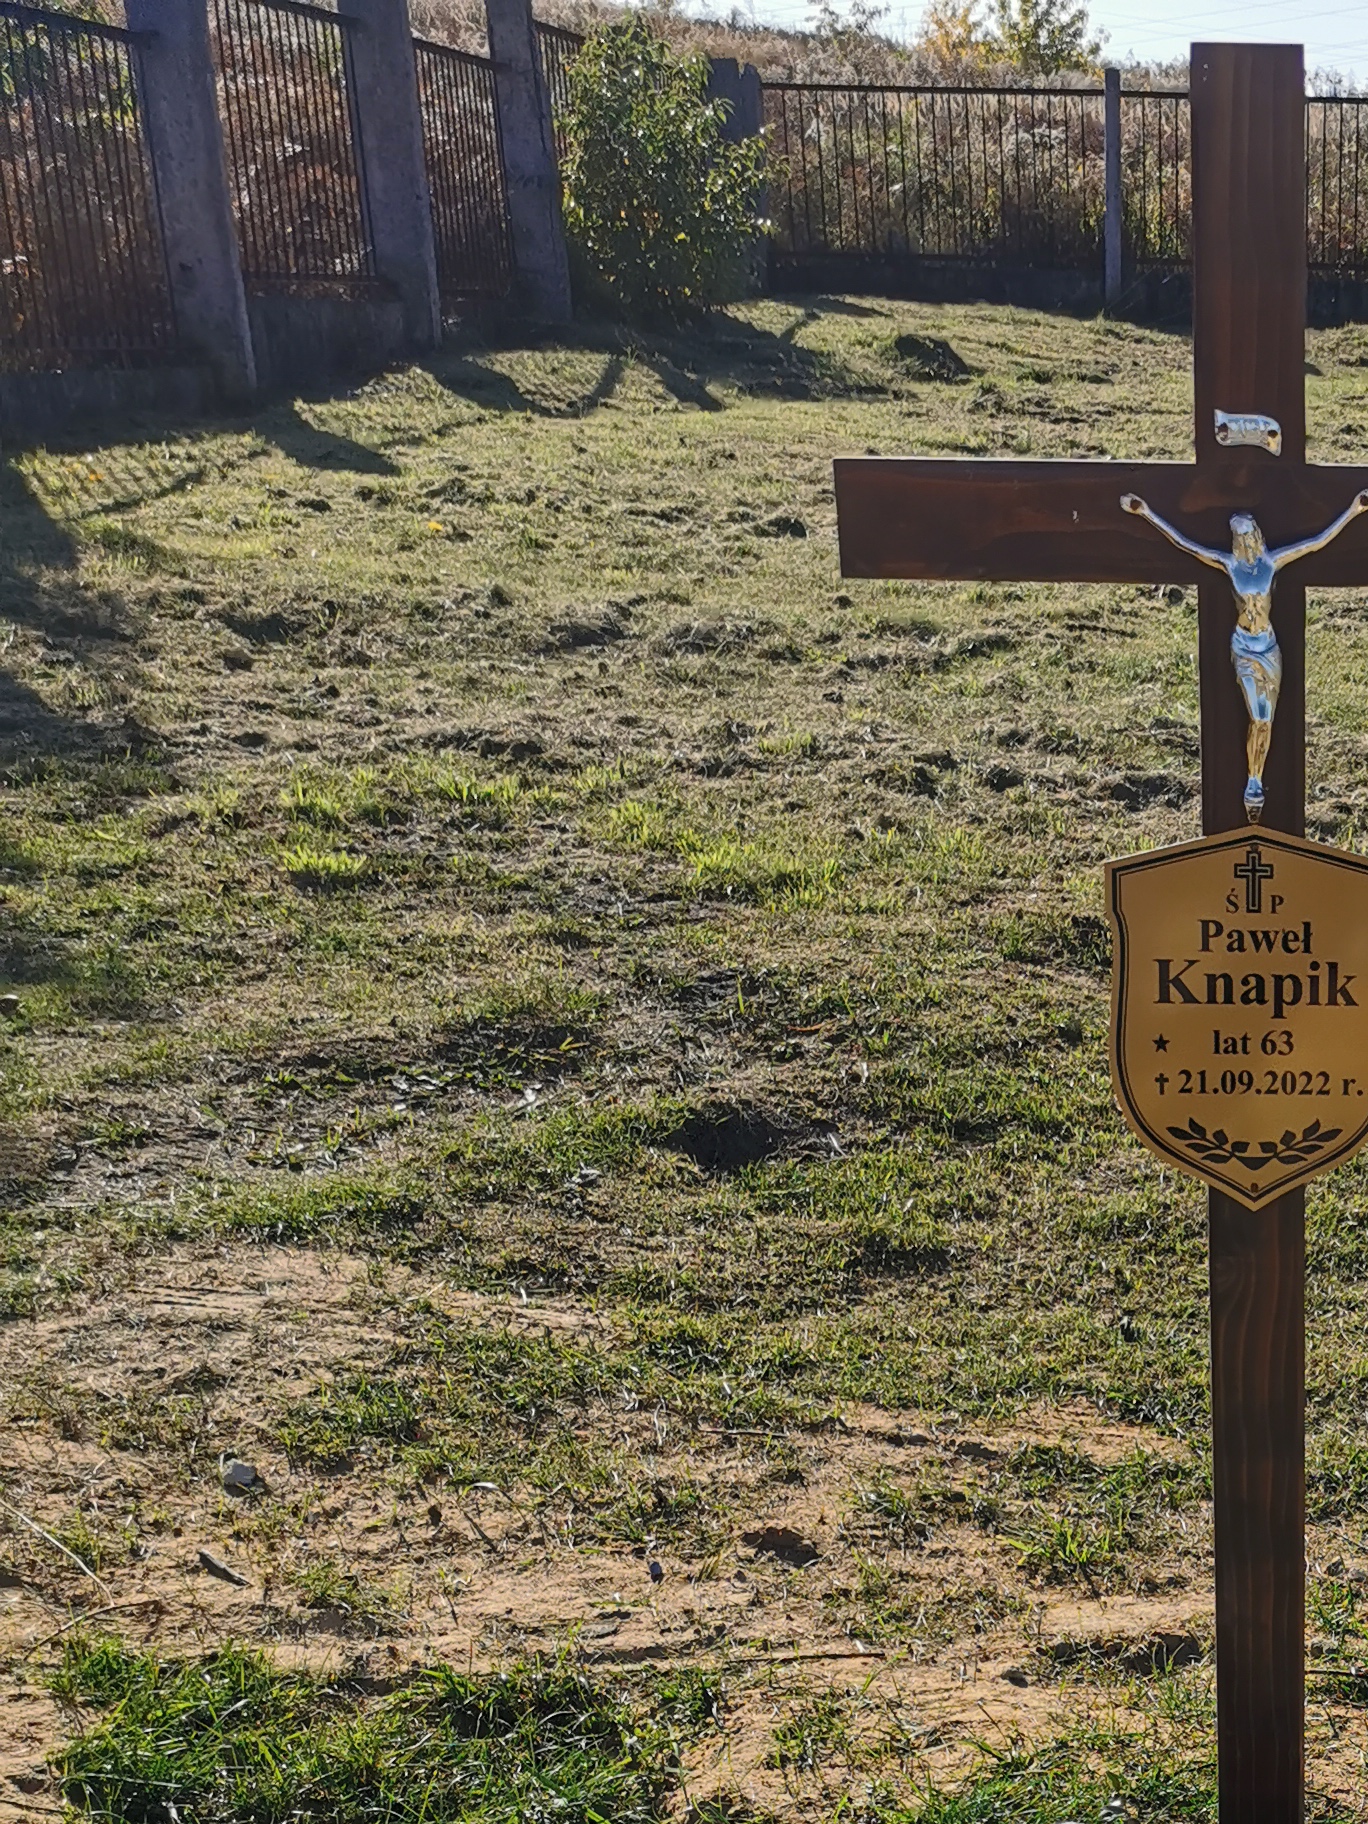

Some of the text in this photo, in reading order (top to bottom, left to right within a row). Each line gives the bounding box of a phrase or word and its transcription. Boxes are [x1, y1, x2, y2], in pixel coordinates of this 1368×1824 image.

[1225, 887, 1285, 915] Ś P
[1197, 918, 1314, 955] Paweł
[1152, 958, 1360, 1020] Knapik
[1212, 1029, 1295, 1056] lat 63
[1177, 1068, 1364, 1097] 21.09.2022 r.
